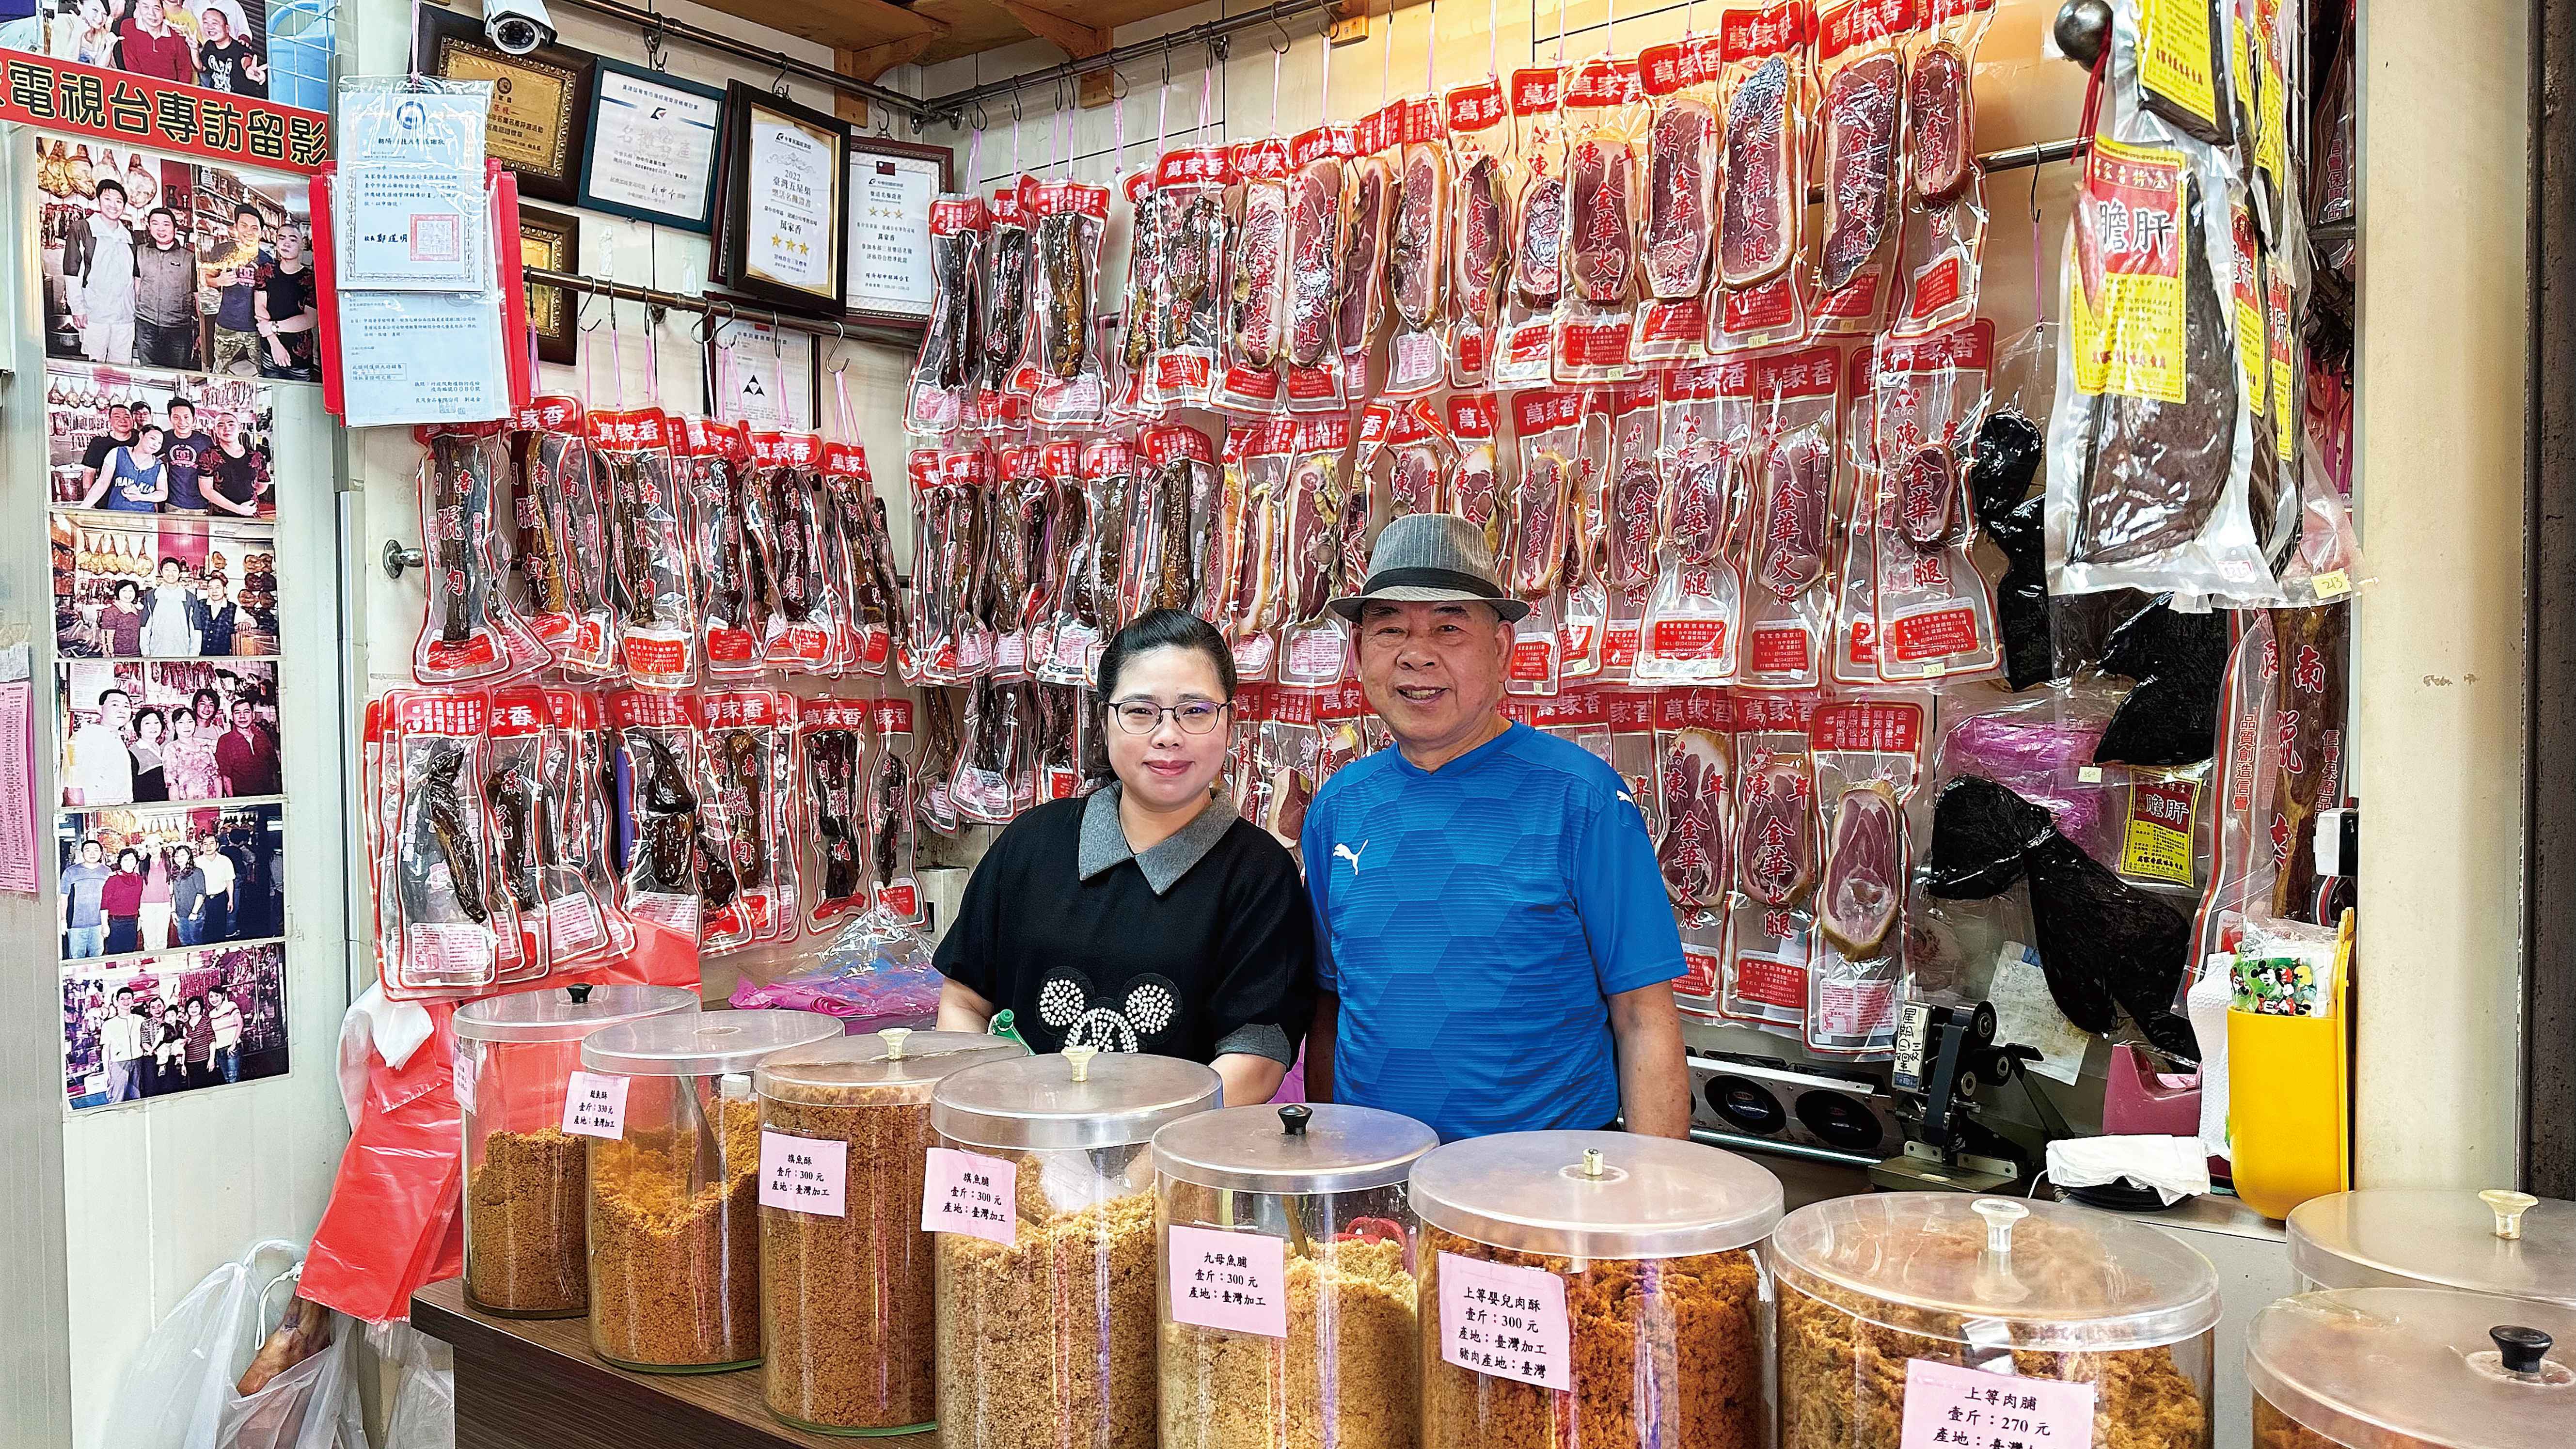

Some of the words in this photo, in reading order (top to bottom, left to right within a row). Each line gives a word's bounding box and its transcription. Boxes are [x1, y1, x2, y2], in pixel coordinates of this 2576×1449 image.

[0, 62, 328, 166] 電視台專訪留影
[785, 170, 801, 182] 2022
[1165, 158, 1224, 176] 萬家香
[1739, 138, 1776, 267] 金華火腿
[780, 220, 802, 236] 萬家香
[1588, 182, 1623, 302] 金華火腿
[1663, 164, 1699, 290] 金華火腿
[2100, 198, 2175, 257] 膽肝
[755, 441, 811, 462] 萬家香
[831, 453, 869, 472] 萬家
[1624, 487, 1655, 608] 金華火腿
[1770, 481, 1808, 605] 金華火腿
[2322, 577, 2342, 589] 213
[1928, 666, 1942, 674] 221
[873, 708, 907, 724] 家香
[2232, 715, 2257, 811] 品質創造信譽
[2314, 729, 2340, 828] 信譽保證品
[1664, 772, 1728, 810] 陳年
[1743, 772, 1811, 810] 陳年
[2146, 794, 2189, 824] 膽肝
[1674, 810, 1710, 929] 金華火腿
[1759, 816, 1795, 940] 金華火腿
[1464, 1286, 1541, 1313] 上等嬰兒肉酥
[1964, 1386, 2037, 1411] 上等肉脯
